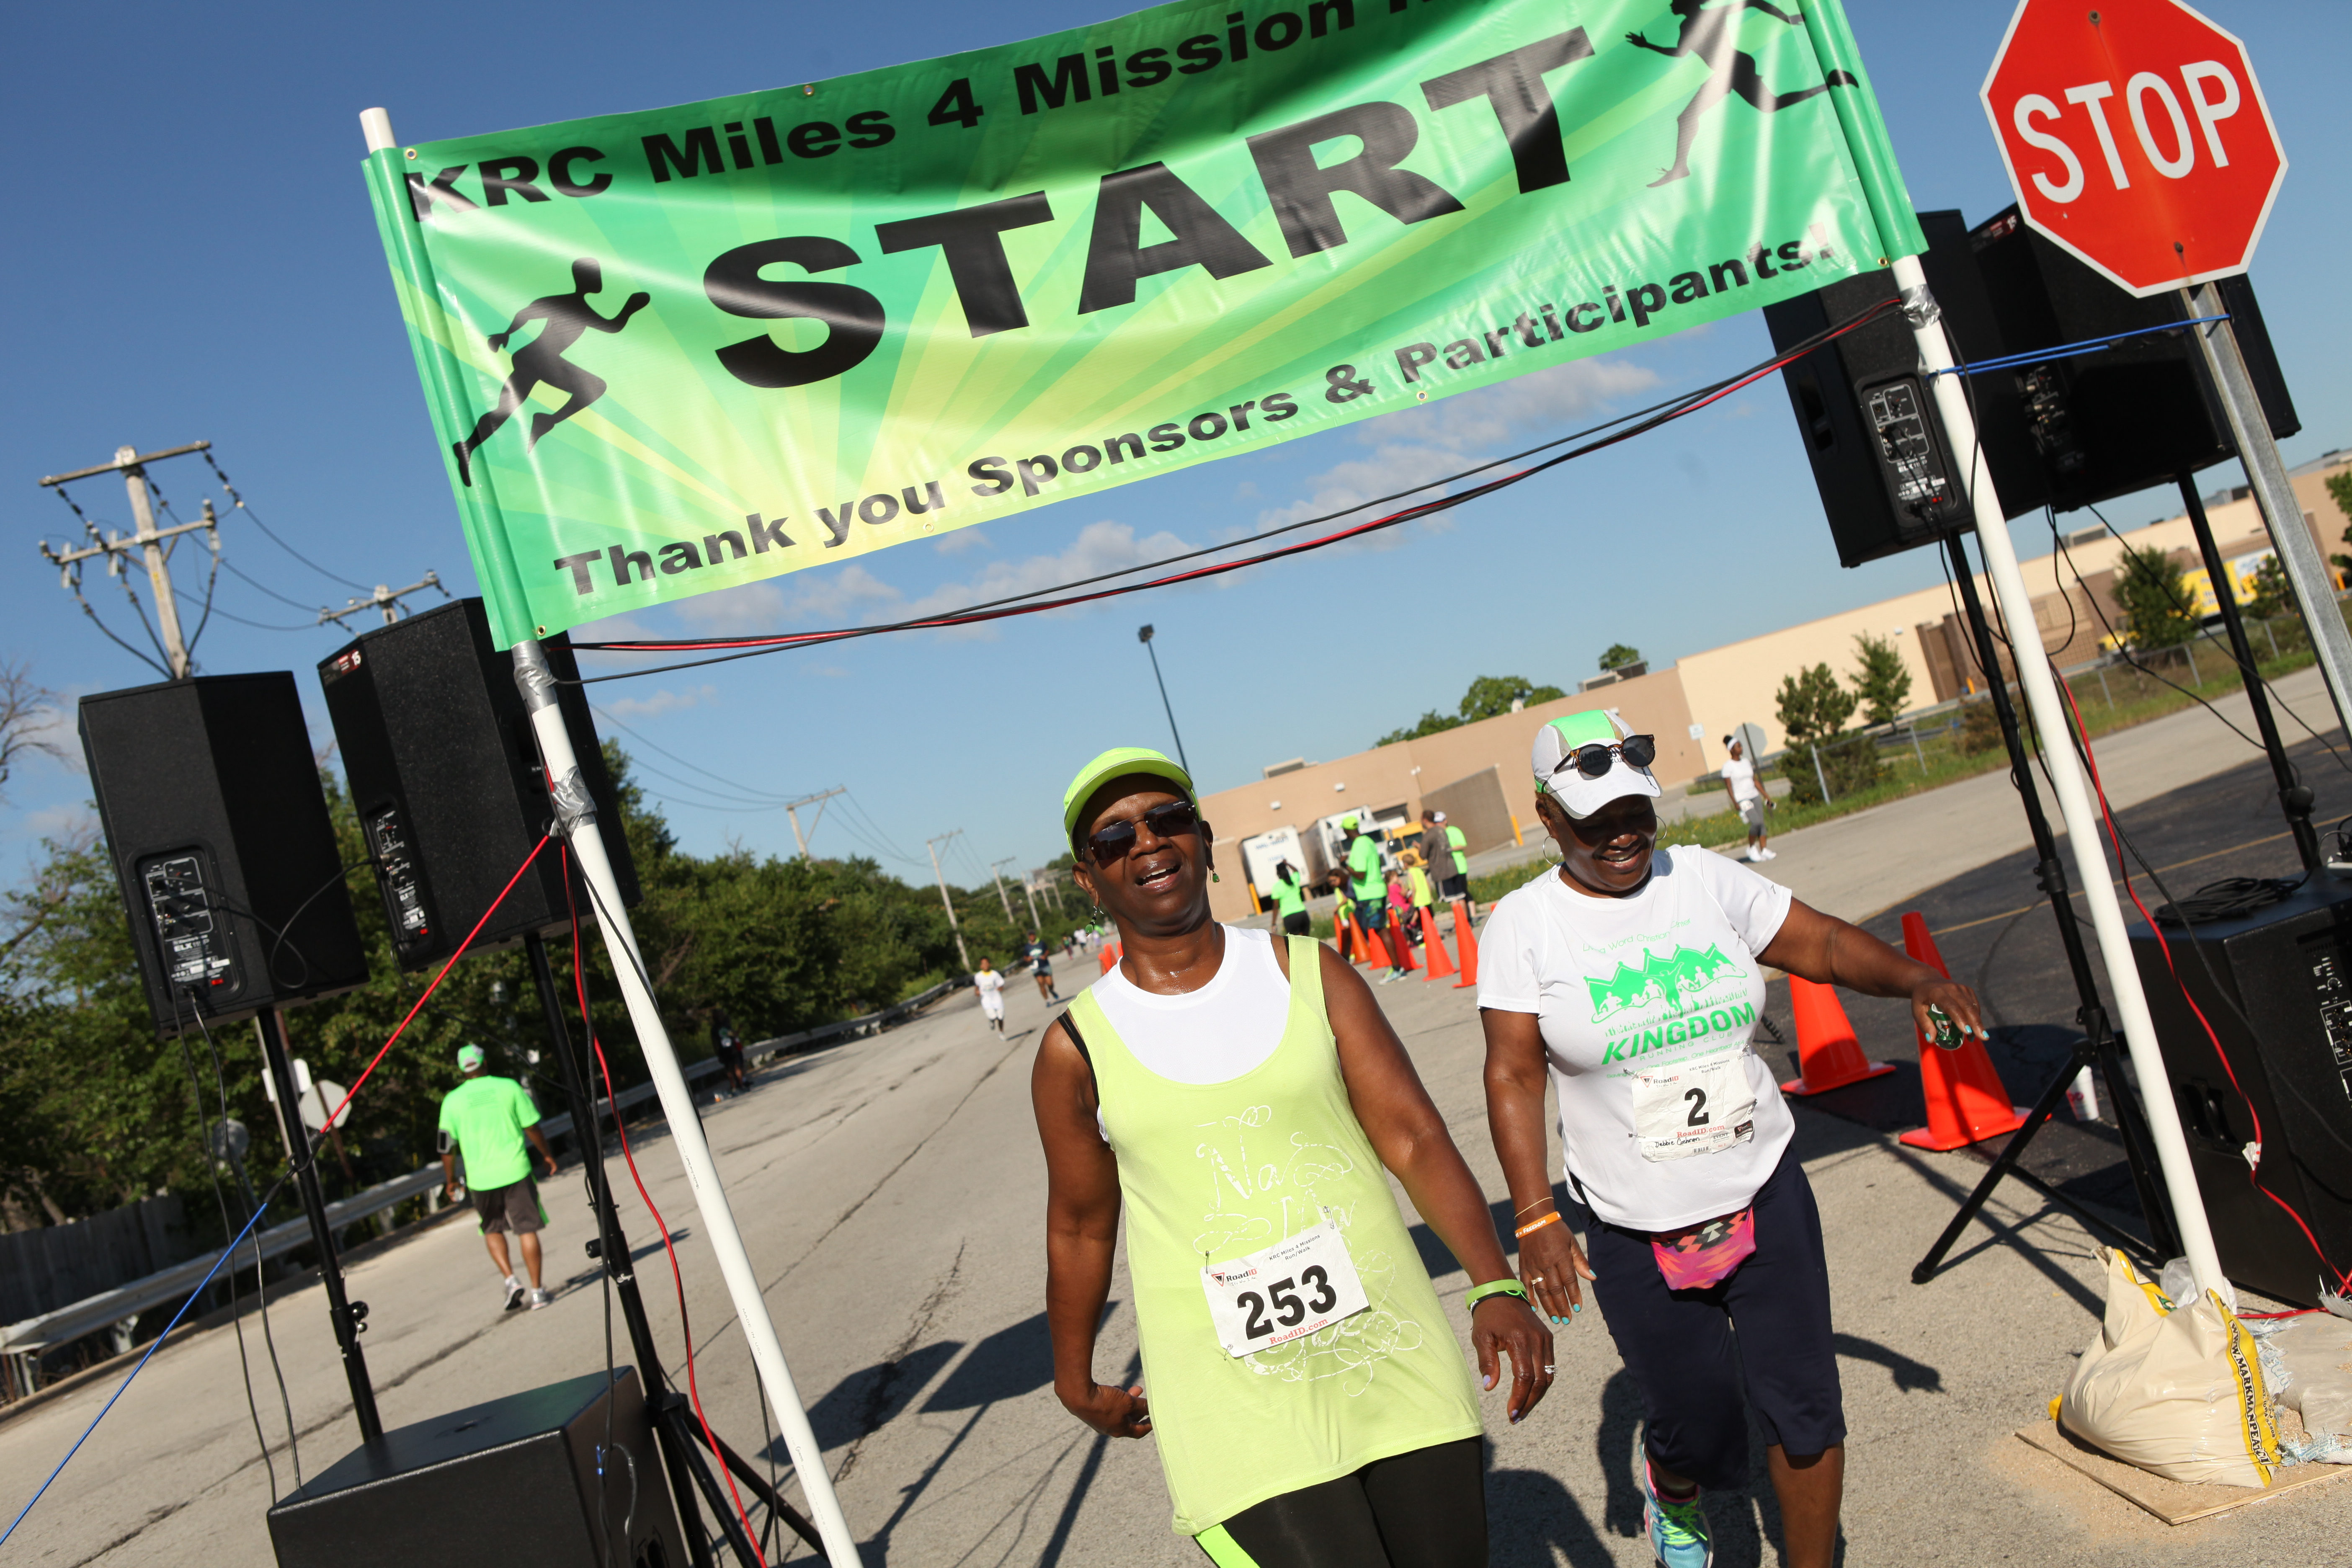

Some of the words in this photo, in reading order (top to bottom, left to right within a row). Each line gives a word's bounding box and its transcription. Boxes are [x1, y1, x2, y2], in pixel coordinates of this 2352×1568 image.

[403, 146, 613, 222] KRC
[641, 109, 896, 183] Miles
[926, 77, 984, 129] 4
[1013, 0, 1355, 116] Mission
[2013, 59, 2241, 204] STOP
[703, 25, 1596, 389] START
[554, 512, 797, 596] Thank
[814, 480, 946, 549] you
[967, 391, 1299, 498] Sponsors
[1324, 364, 1377, 404] &
[1394, 221, 1836, 384] Participants!
[1607, 935, 1633, 951] Word
[1636, 931, 1671, 942] Christian
[1601, 1001, 1756, 1065] KINGDOM
[1639, 1041, 1694, 1061] RUNNING
[1703, 1031, 1733, 1043] CLUB
[1706, 1043, 1733, 1055] Heartbeat
[1653, 1075, 1679, 1084] RoadID
[1701, 1065, 1721, 1074] Run/Walk
[1684, 1087, 1709, 1127] 2
[1655, 1140, 1675, 1148] Debbie
[1676, 1136, 1700, 1145] Cochran
[1676, 1125, 1725, 1138] RoadID.com
[1269, 1253, 1281, 1261] KRC
[1281, 1247, 1295, 1256] Miles
[1300, 1234, 1320, 1248] Missions
[1285, 1246, 1311, 1261] Run/Walk
[1226, 1268, 1257, 1282] RoadID
[1237, 1265, 1337, 1340] 253
[1269, 1319, 1328, 1344] RoadID.com
